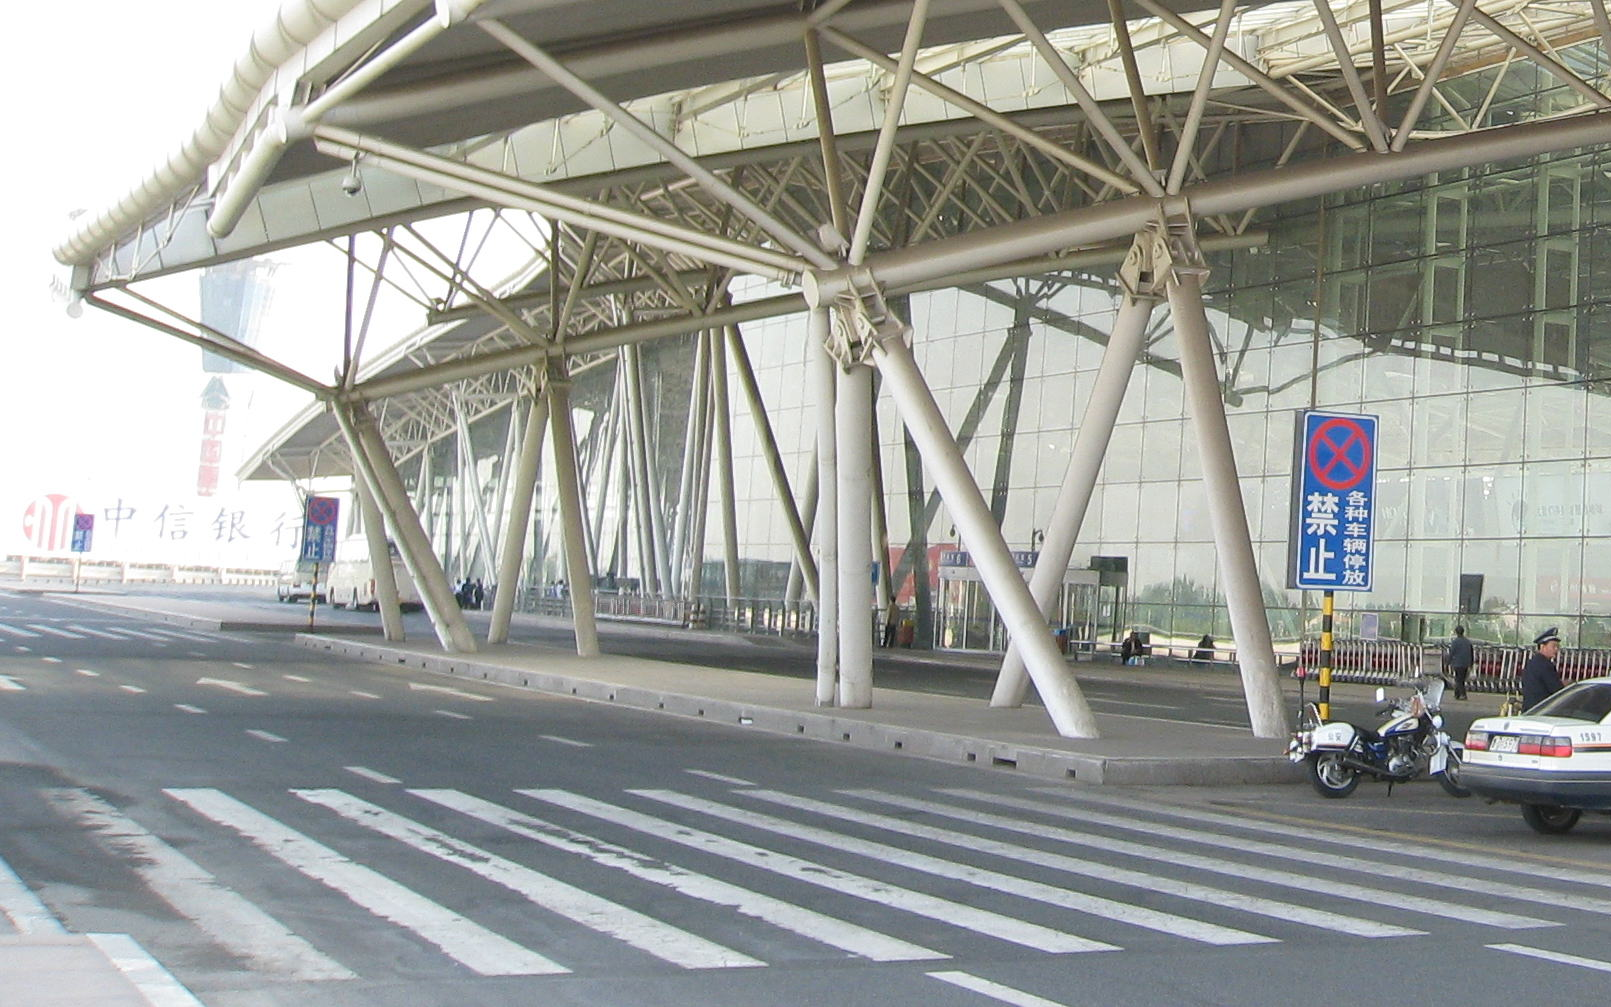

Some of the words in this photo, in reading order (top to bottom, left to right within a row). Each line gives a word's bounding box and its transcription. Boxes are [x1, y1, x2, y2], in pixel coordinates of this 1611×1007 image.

[104, 498, 304, 549] 中信银行
[1303, 492, 1339, 580] 禁止
[1342, 490, 1368, 585] 各种车辆停放
[1580, 732, 1602, 742] 1597
